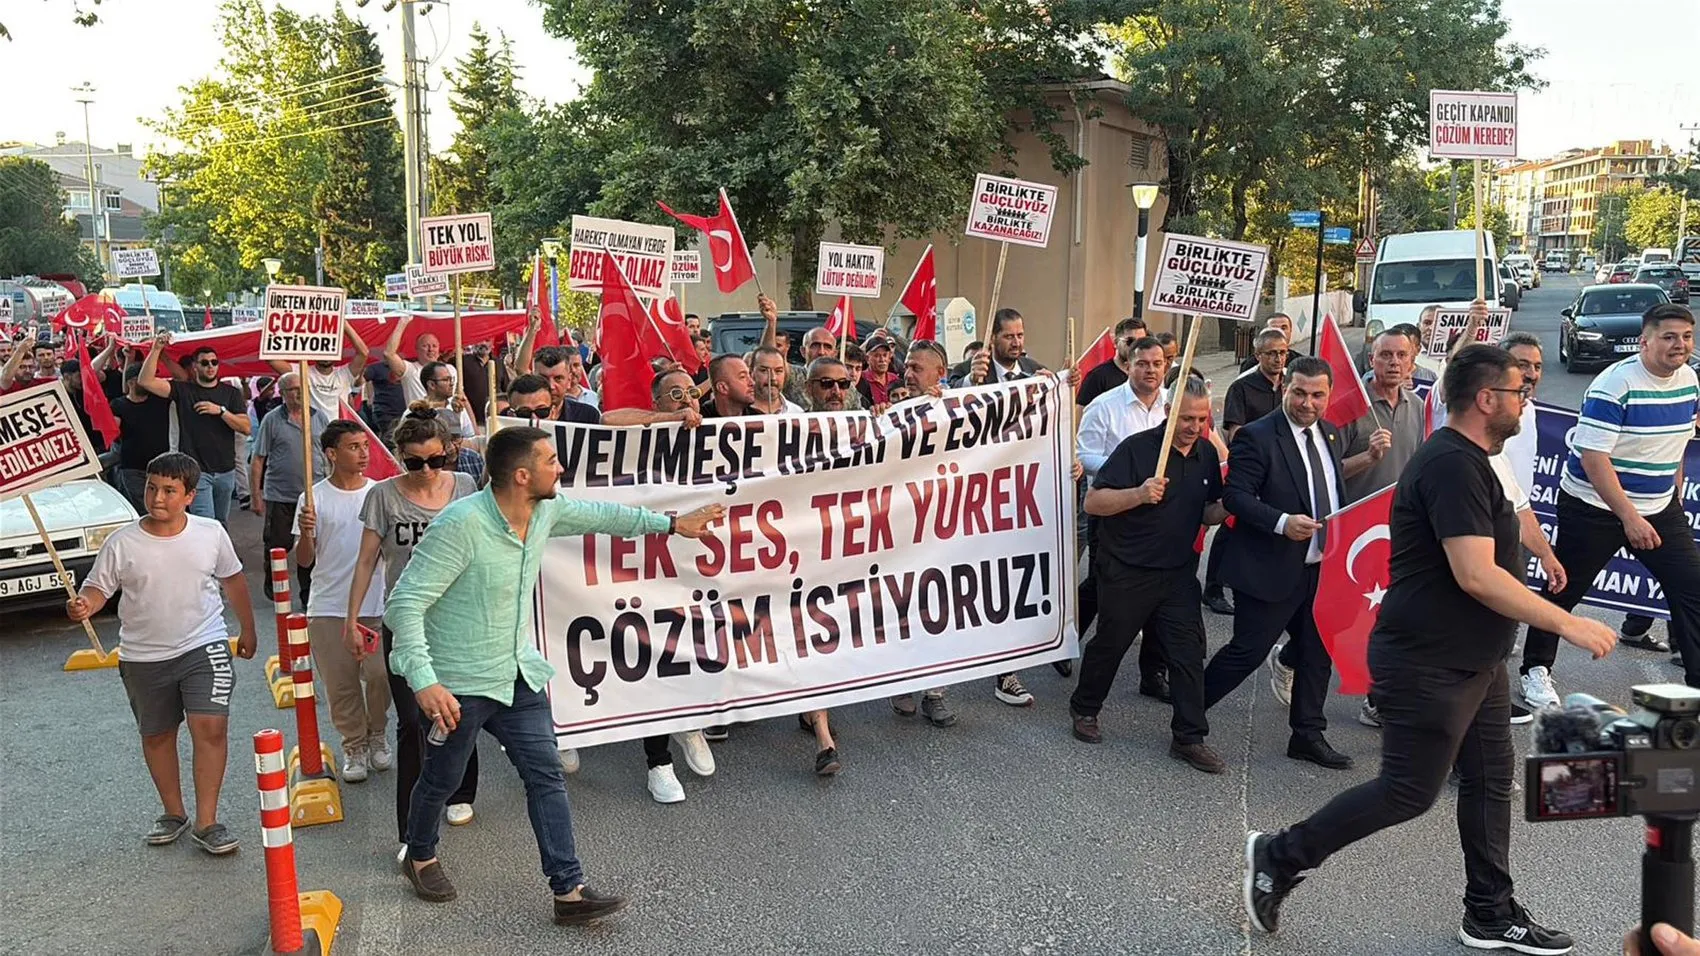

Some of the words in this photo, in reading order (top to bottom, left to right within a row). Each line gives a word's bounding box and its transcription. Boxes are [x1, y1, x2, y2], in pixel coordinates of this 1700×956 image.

[1437, 101, 1467, 124] GEÇİT
[1470, 104, 1513, 123] KAPANDI
[1436, 123, 1470, 146] ÇÖZÜM
[1474, 127, 1513, 145] NEREDE?
[980, 193, 1048, 213] GÜÇLÜYÜZ
[985, 182, 1045, 201] BİRLİKTE
[428, 225, 455, 245] TEK
[458, 222, 486, 242] YOL,
[987, 215, 1032, 230] BİRLİKTE
[574, 228, 608, 246] HAREKET
[608, 233, 643, 250] OLMAYAN
[644, 238, 667, 254] YERDE
[429, 245, 464, 266] BÜYÜK
[465, 243, 490, 263] RİSK!
[828, 251, 843, 268] YOL
[846, 253, 876, 271] HAKTIR,
[1175, 243, 1252, 266] BİRLİKTE
[570, 249, 625, 281] BERET
[625, 256, 665, 288] OLMAZ
[822, 268, 845, 286] LÜTUF
[846, 271, 877, 289] DEĞİLDİR!
[1167, 257, 1256, 281] GÜÇLÜYÜZ
[270, 292, 307, 309] ÜRETEN
[309, 294, 340, 311] KÖYLÜ
[1159, 292, 1247, 314] KAZANACAĞIZ!
[1176, 285, 1235, 302] BİRLİKTE
[268, 309, 339, 335] ÇÖZÜM
[267, 334, 337, 352] İSTİYOR!
[777, 415, 887, 475] HALKI
[889, 402, 938, 460] VE
[942, 381, 1050, 452] ESNAFI
[695, 499, 800, 577] SES,
[810, 485, 894, 561] TEK
[905, 463, 1043, 544] YÜREK
[18, 577, 42, 593] AGJ
[566, 589, 778, 706] ÇÖZÜM
[790, 551, 1052, 658] İSTİYORUZ!
[205, 643, 233, 706] ATHLETIC
